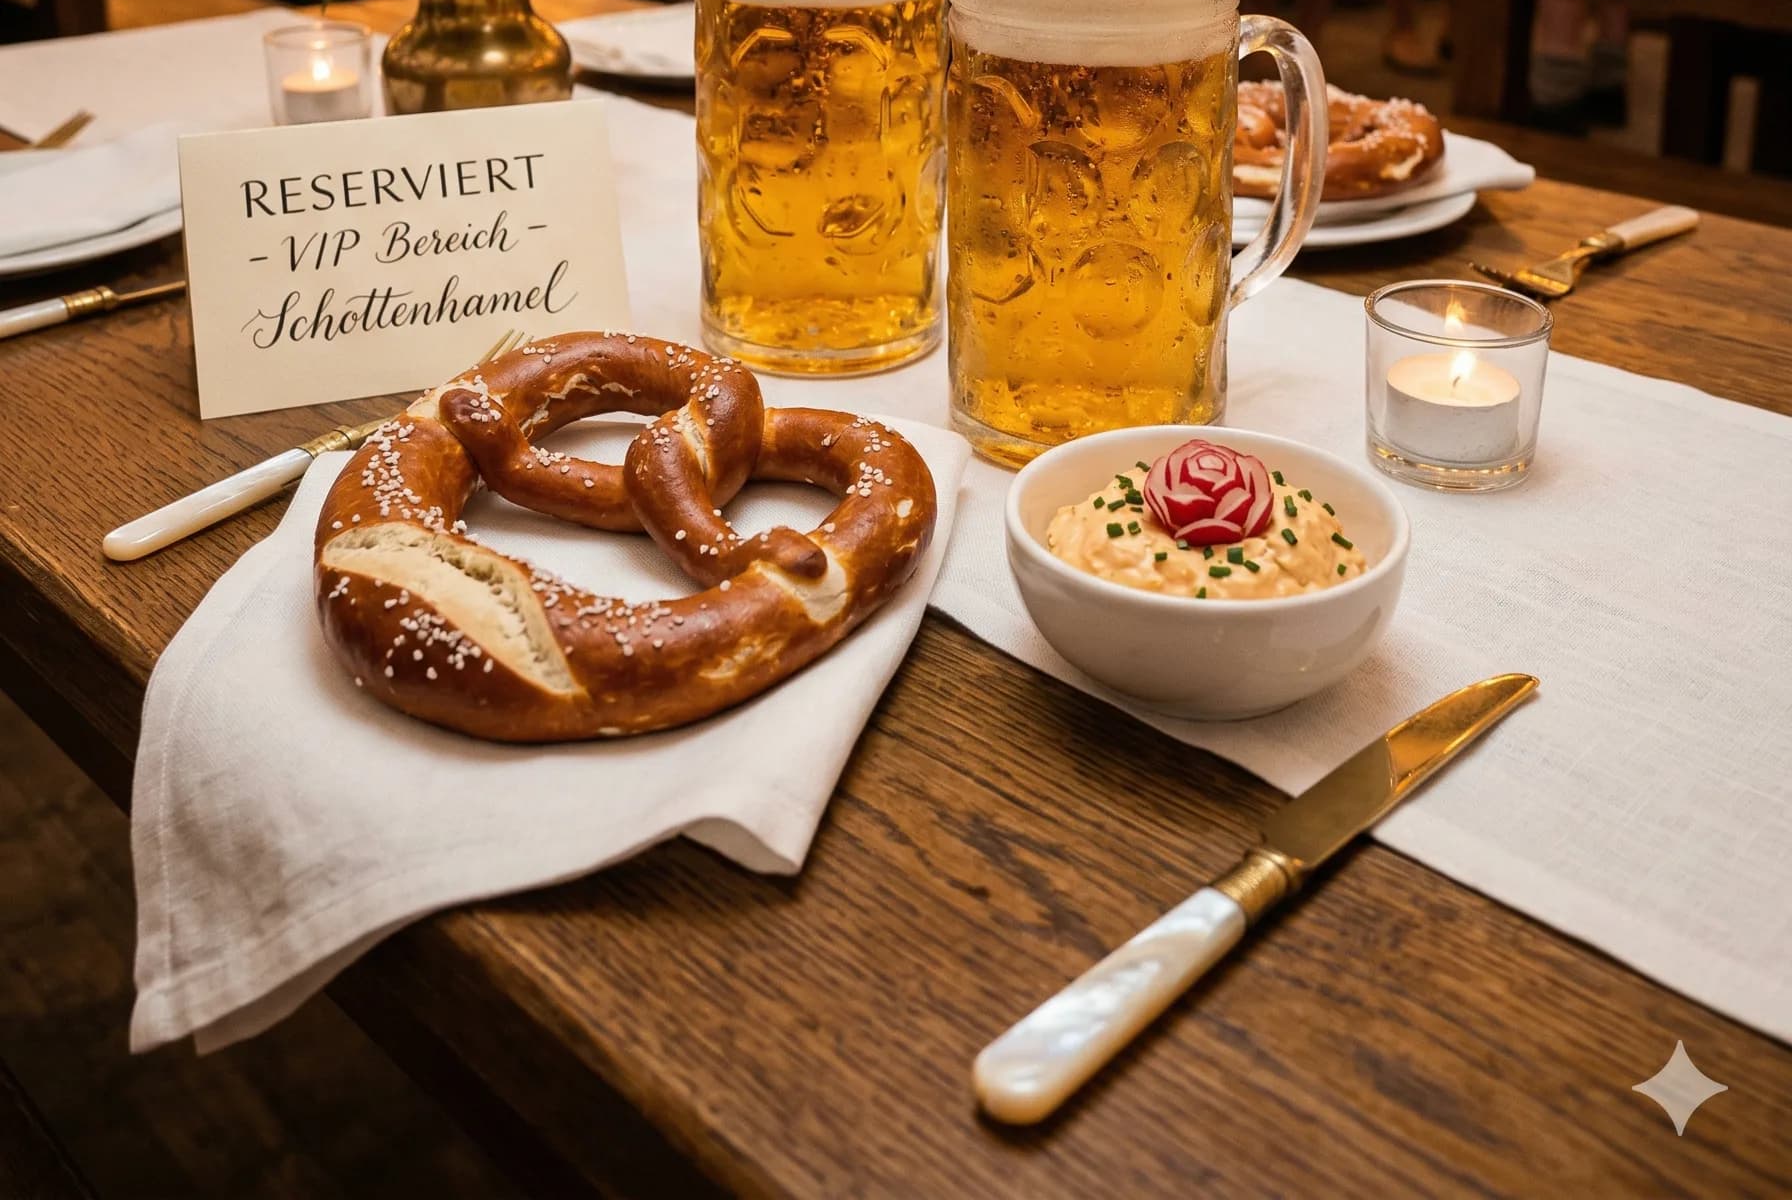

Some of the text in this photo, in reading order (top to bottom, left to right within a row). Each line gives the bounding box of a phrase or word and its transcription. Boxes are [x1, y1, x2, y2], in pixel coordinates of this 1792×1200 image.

[240, 153, 545, 219] RESERVIERT
[281, 228, 361, 273] VIP
[375, 210, 519, 264] Bereich
[241, 260, 578, 350] Schottenhamel
